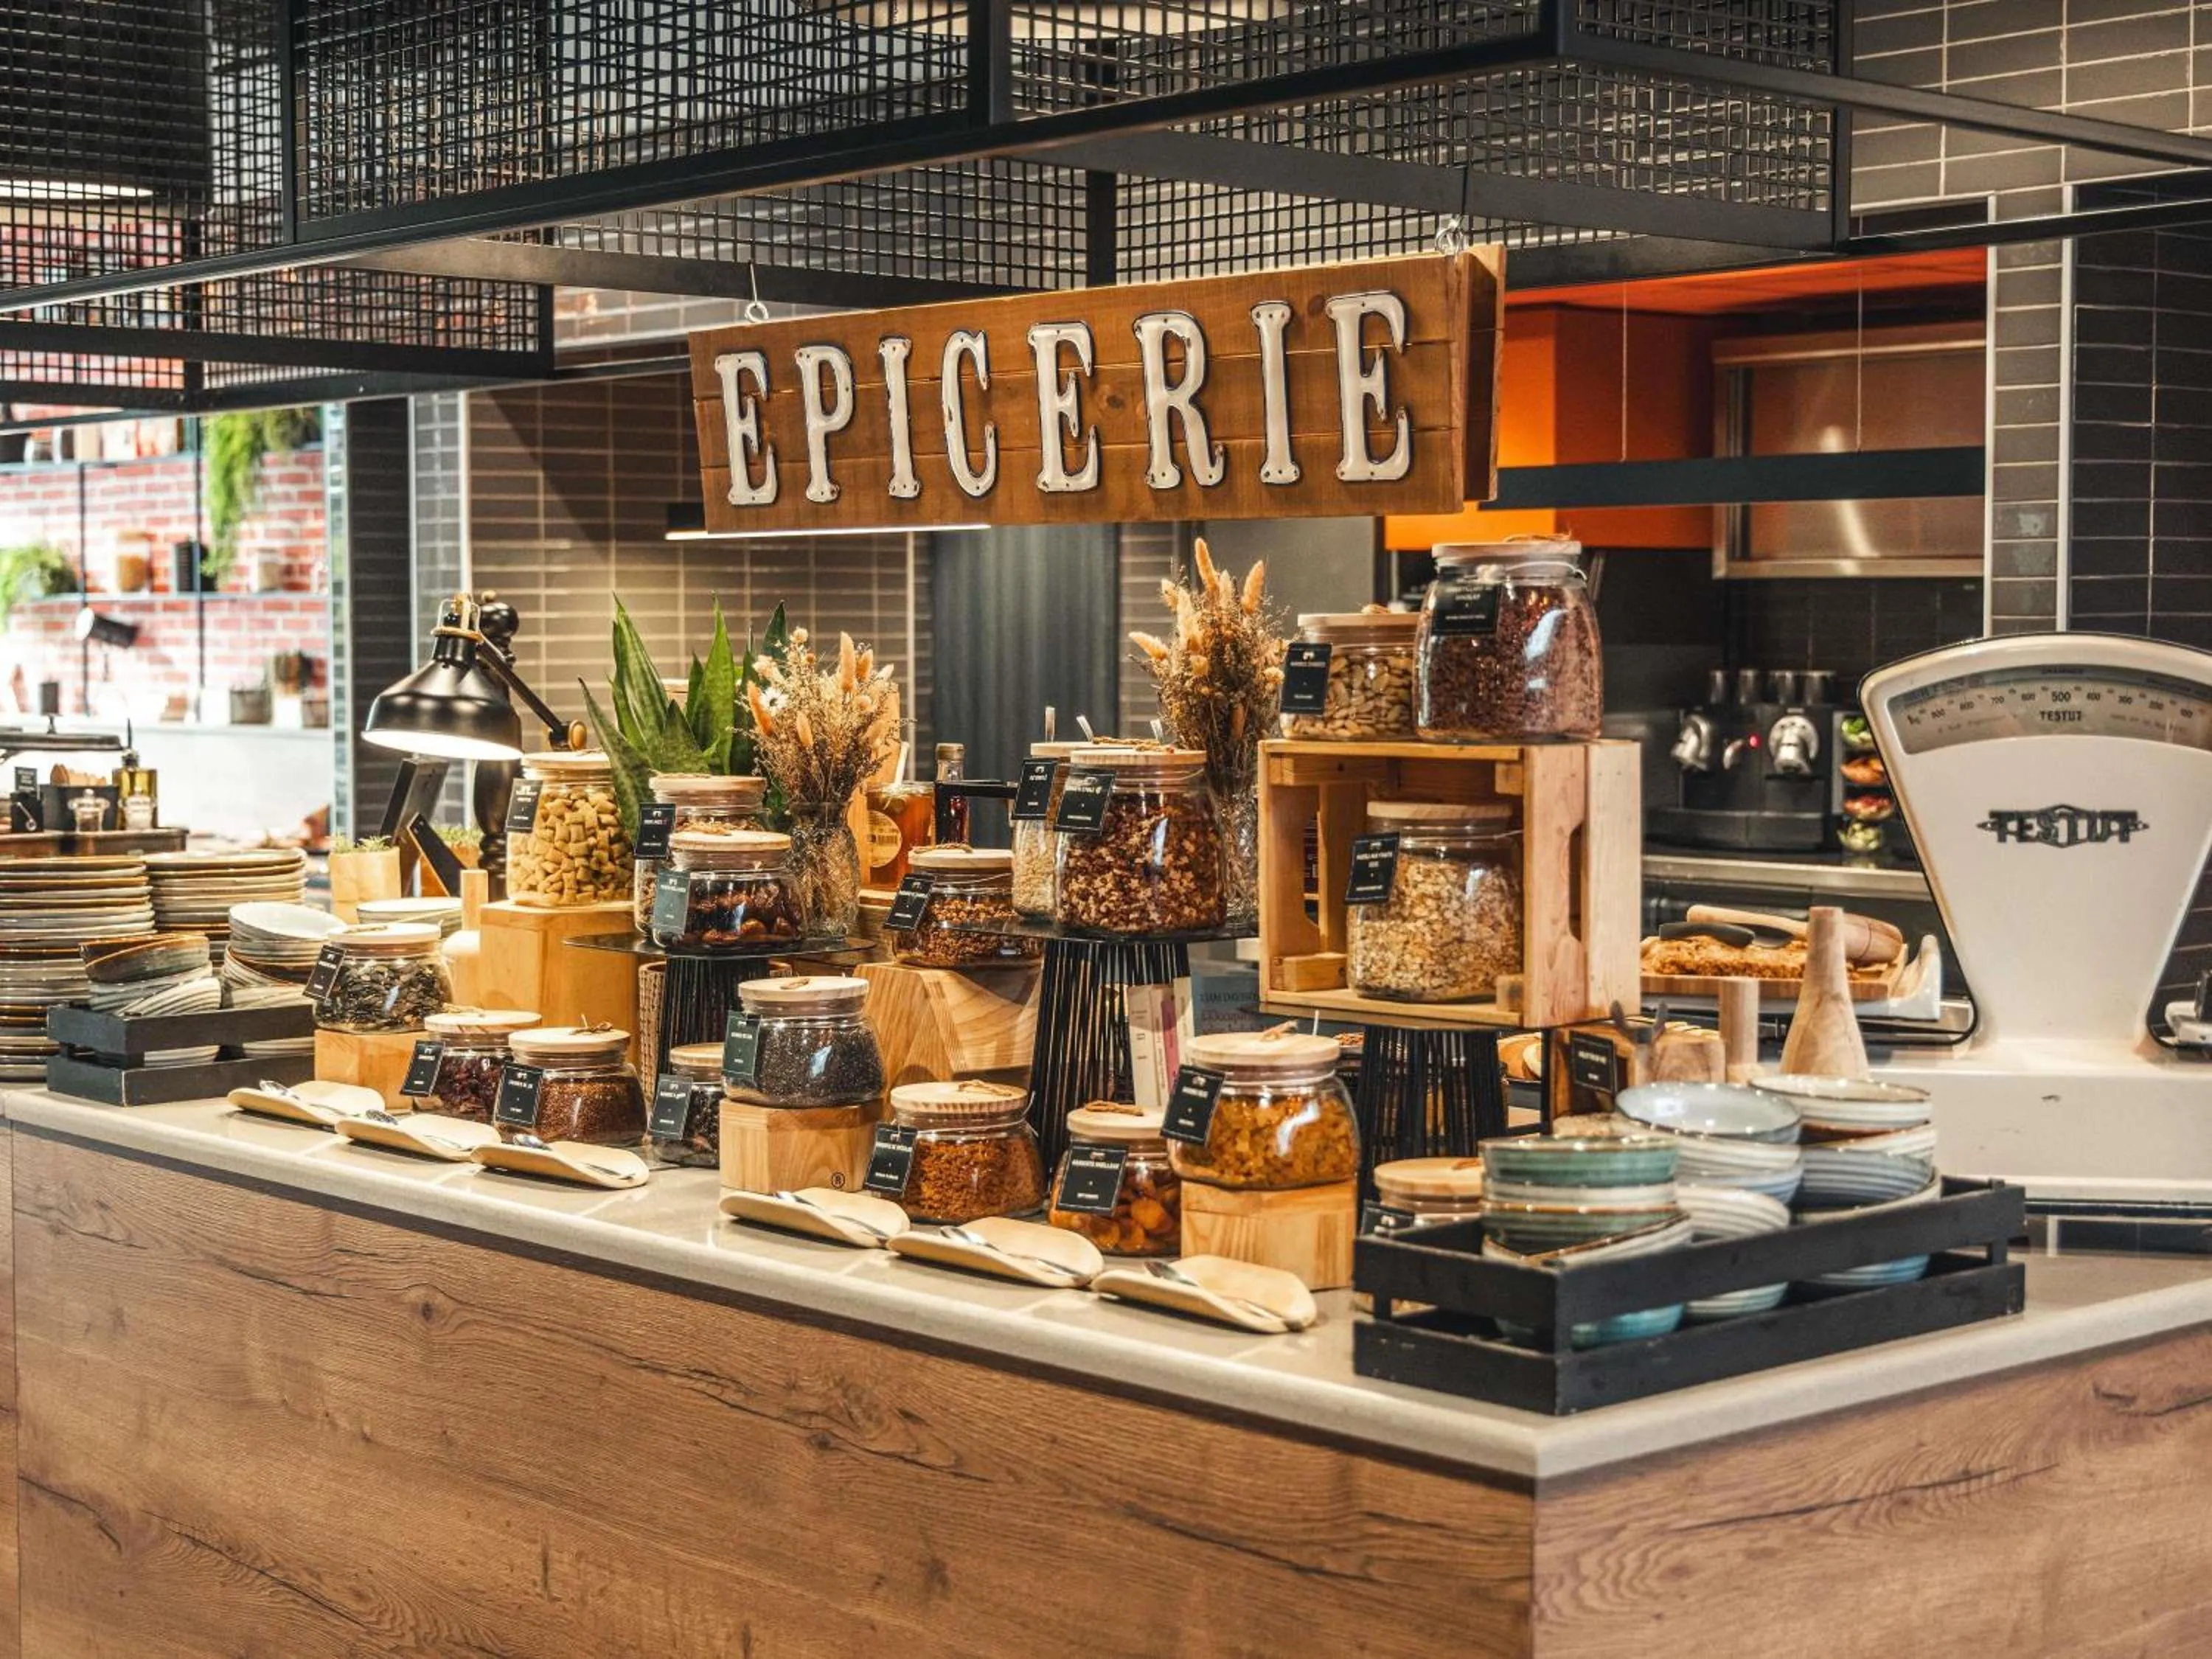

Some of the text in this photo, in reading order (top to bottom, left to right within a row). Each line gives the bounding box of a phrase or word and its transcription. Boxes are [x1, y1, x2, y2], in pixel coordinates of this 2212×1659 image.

[714, 290, 1413, 507] EPICERIE
[2051, 690, 2071, 703] 500
[2039, 710, 2082, 722] TESTUT
[1989, 810, 2138, 844] TESTUT
